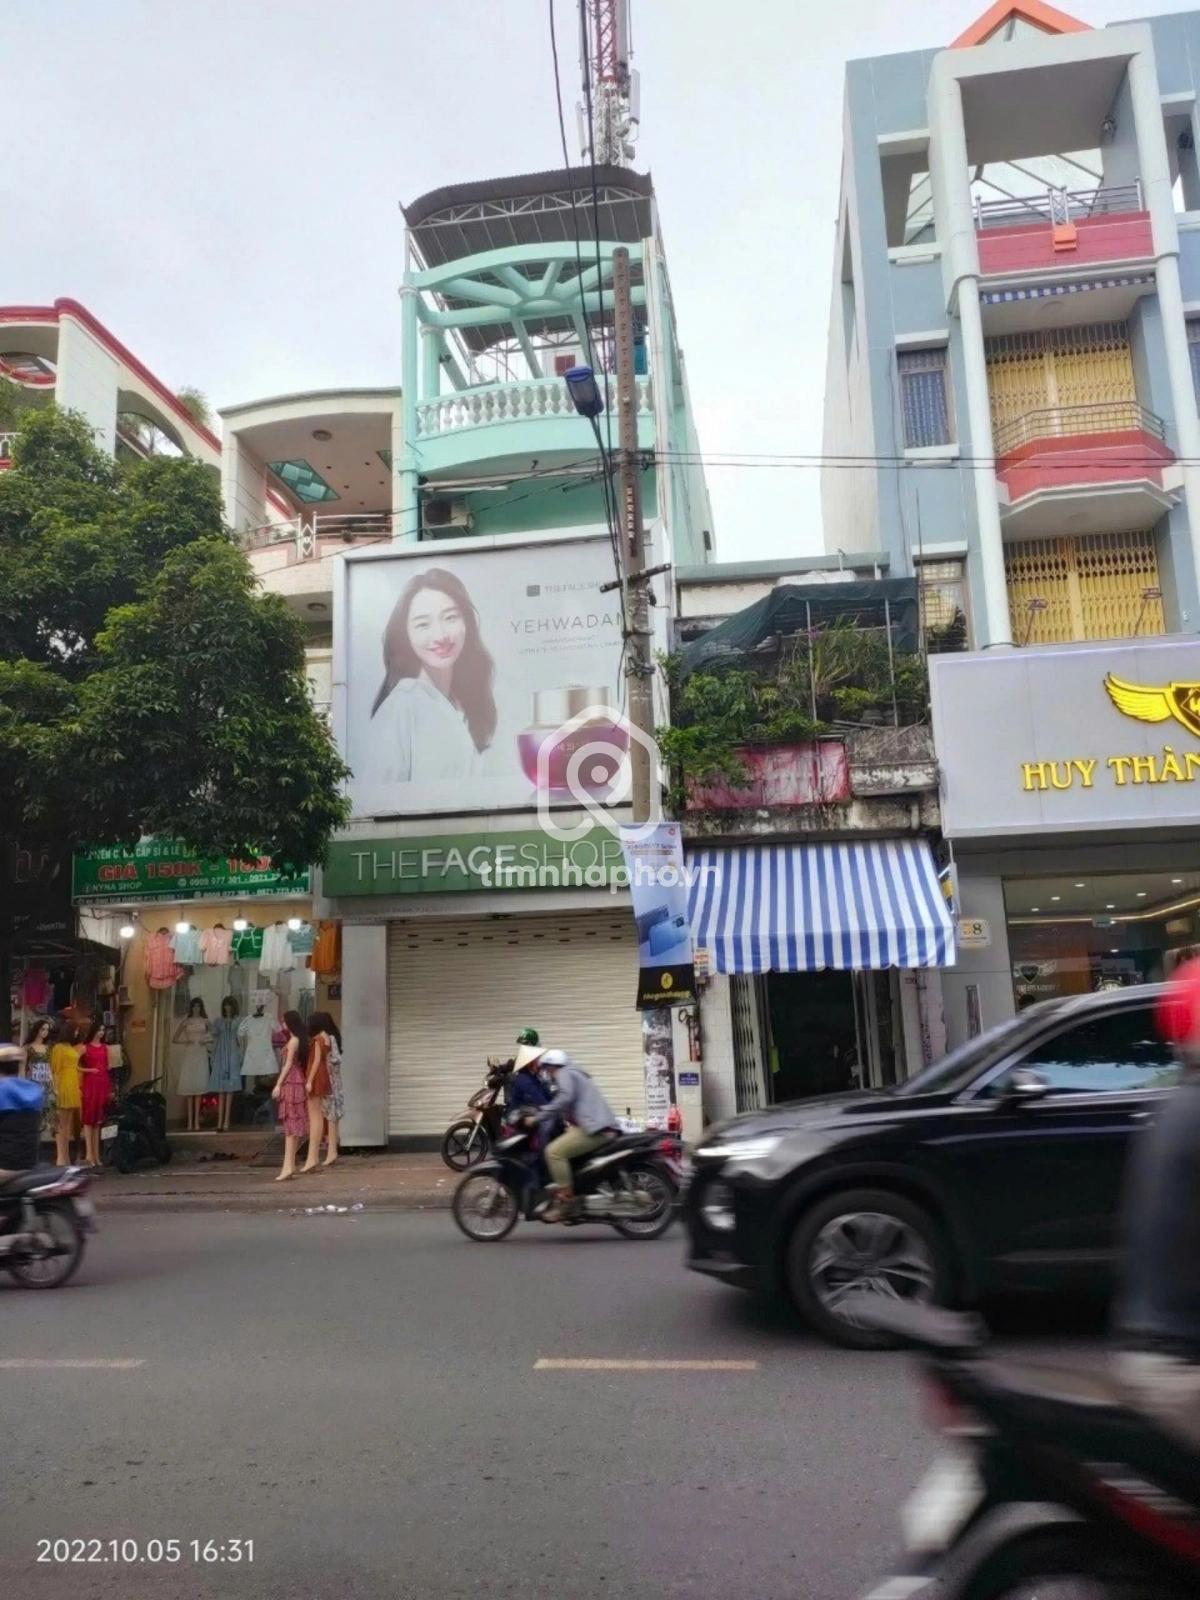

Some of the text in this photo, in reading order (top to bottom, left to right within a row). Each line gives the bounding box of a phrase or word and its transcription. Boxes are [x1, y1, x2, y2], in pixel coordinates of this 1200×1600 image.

[1022, 758, 1096, 790] HUY
[98, 862, 139, 881] GIÁ
[118, 880, 142, 892] SHOP
